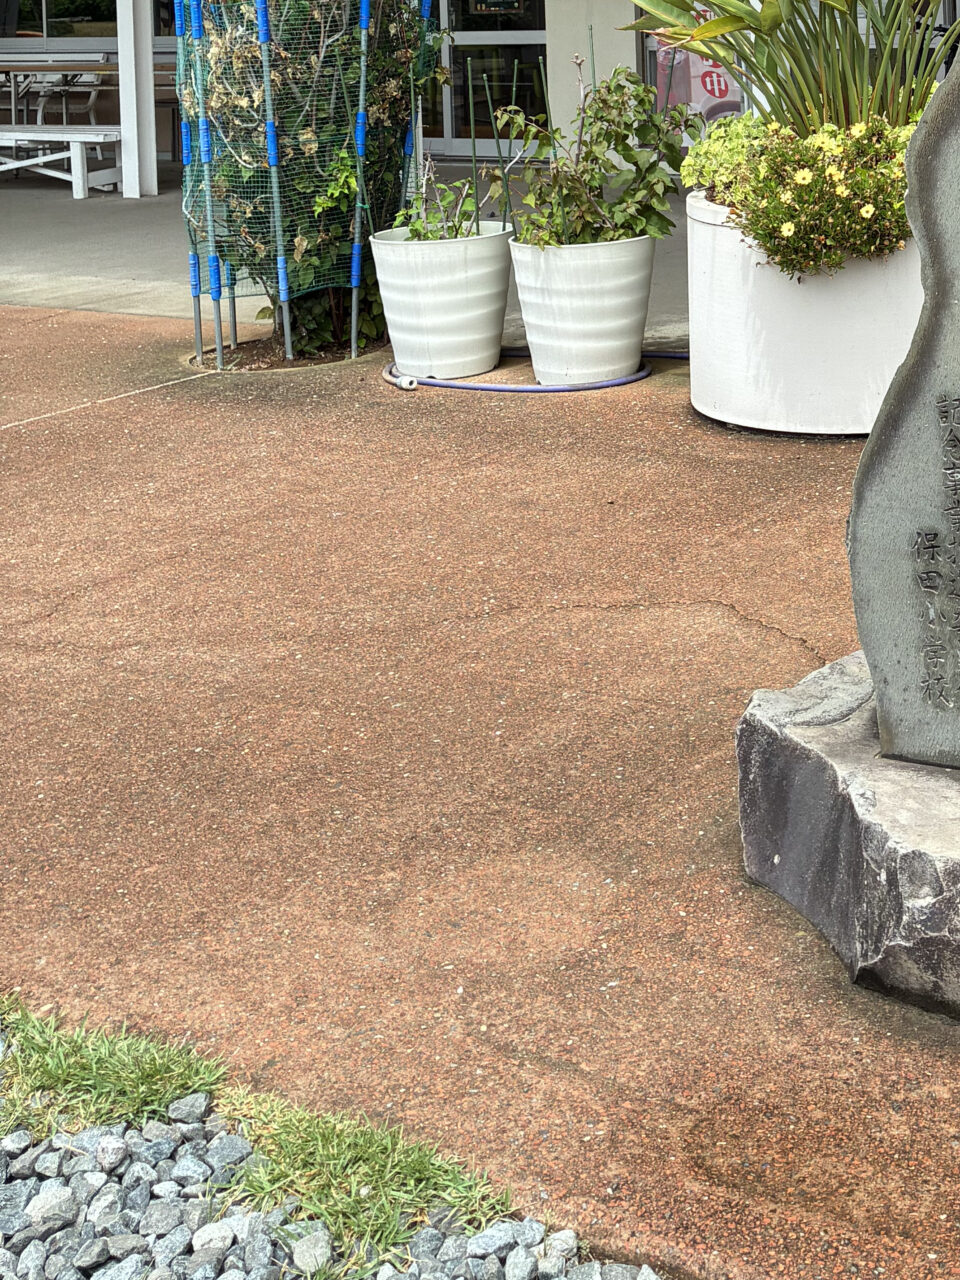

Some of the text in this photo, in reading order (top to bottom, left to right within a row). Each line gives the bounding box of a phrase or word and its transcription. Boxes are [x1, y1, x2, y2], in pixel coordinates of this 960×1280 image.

[912, 531, 954, 708] 保田小学校
